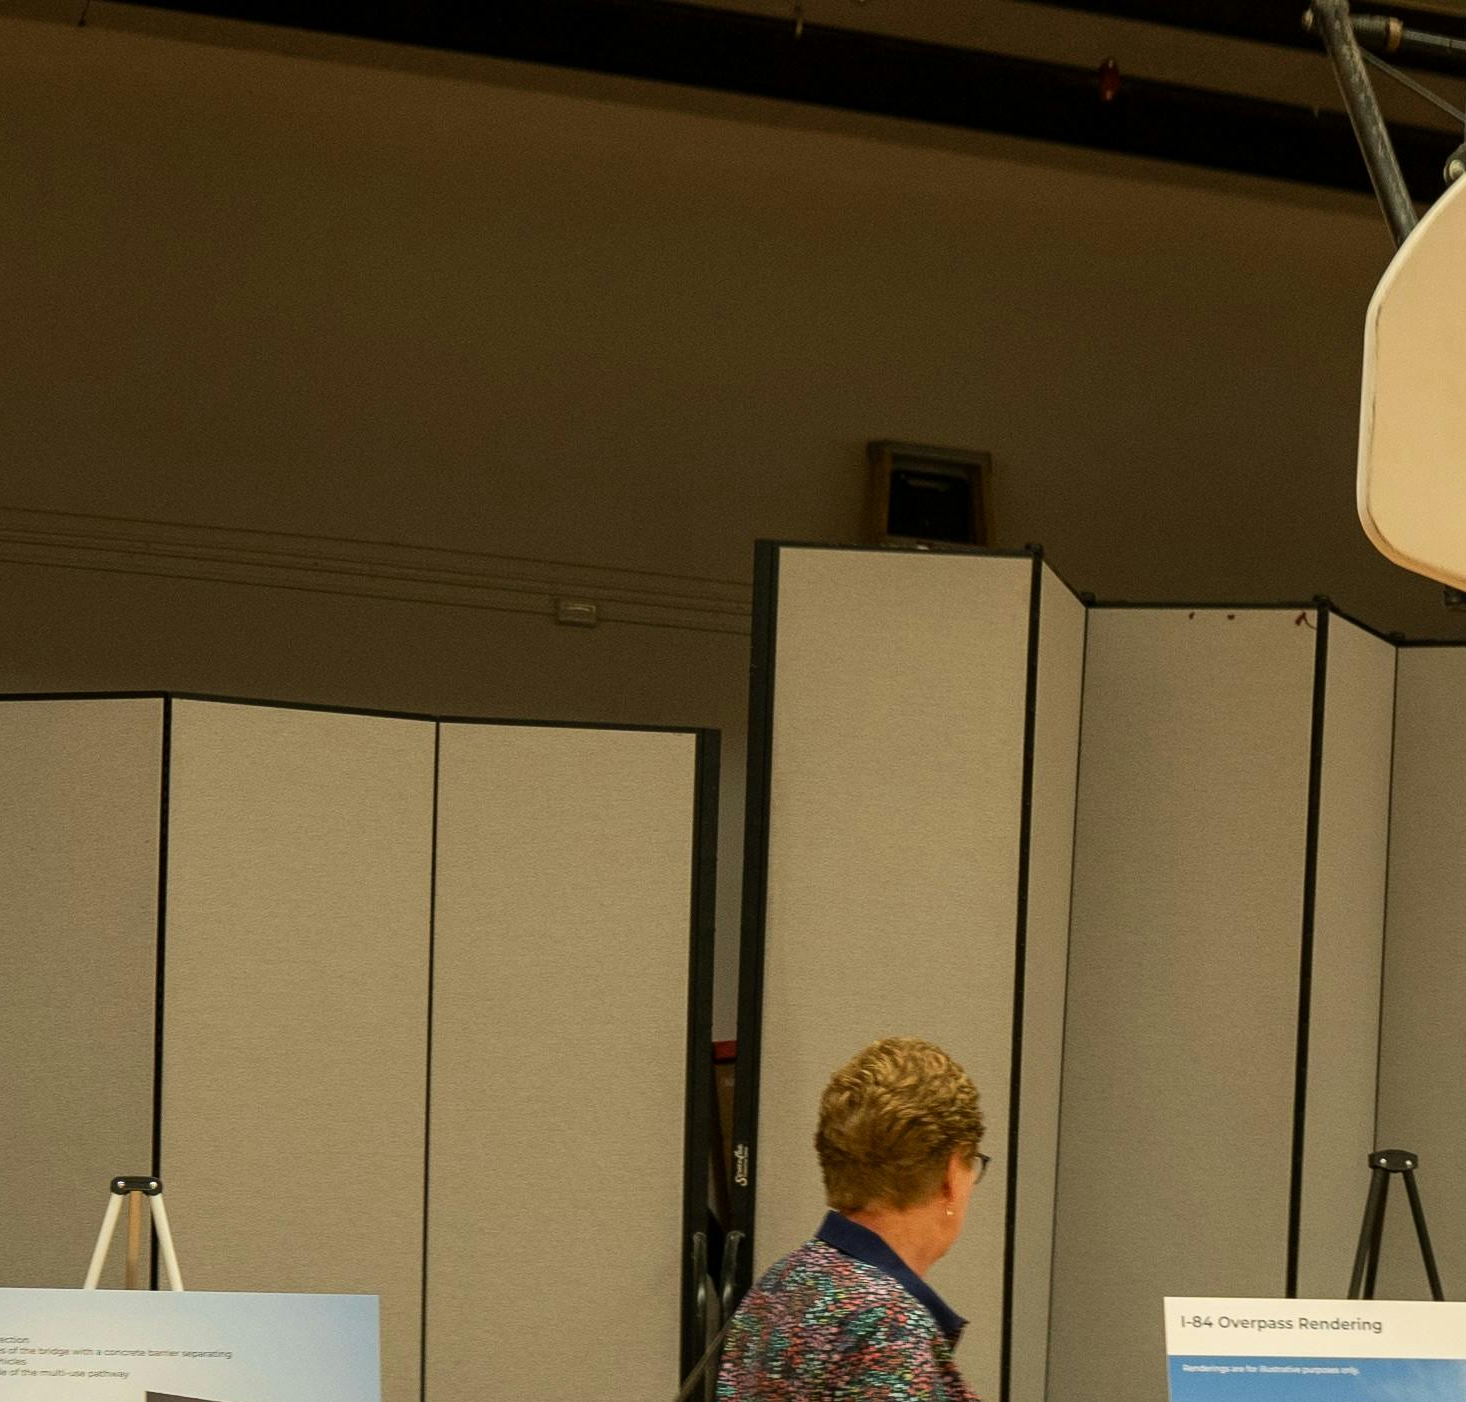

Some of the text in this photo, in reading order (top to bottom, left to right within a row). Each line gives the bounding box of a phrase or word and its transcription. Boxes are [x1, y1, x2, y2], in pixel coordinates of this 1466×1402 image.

[1181, 1315, 1383, 1334] I-84 Overpass Rendering
[20, 1347, 37, 1355] the
[38, 1347, 70, 1357] bridge
[73, 1348, 93, 1356] with
[104, 1349, 146, 1357] concrete
[147, 1349, 179, 1357] barrier
[181, 1350, 233, 1360] separating
[21, 1369, 38, 1377] the
[40, 1369, 85, 1378] multi-use
[88, 1370, 130, 1380] pathway
